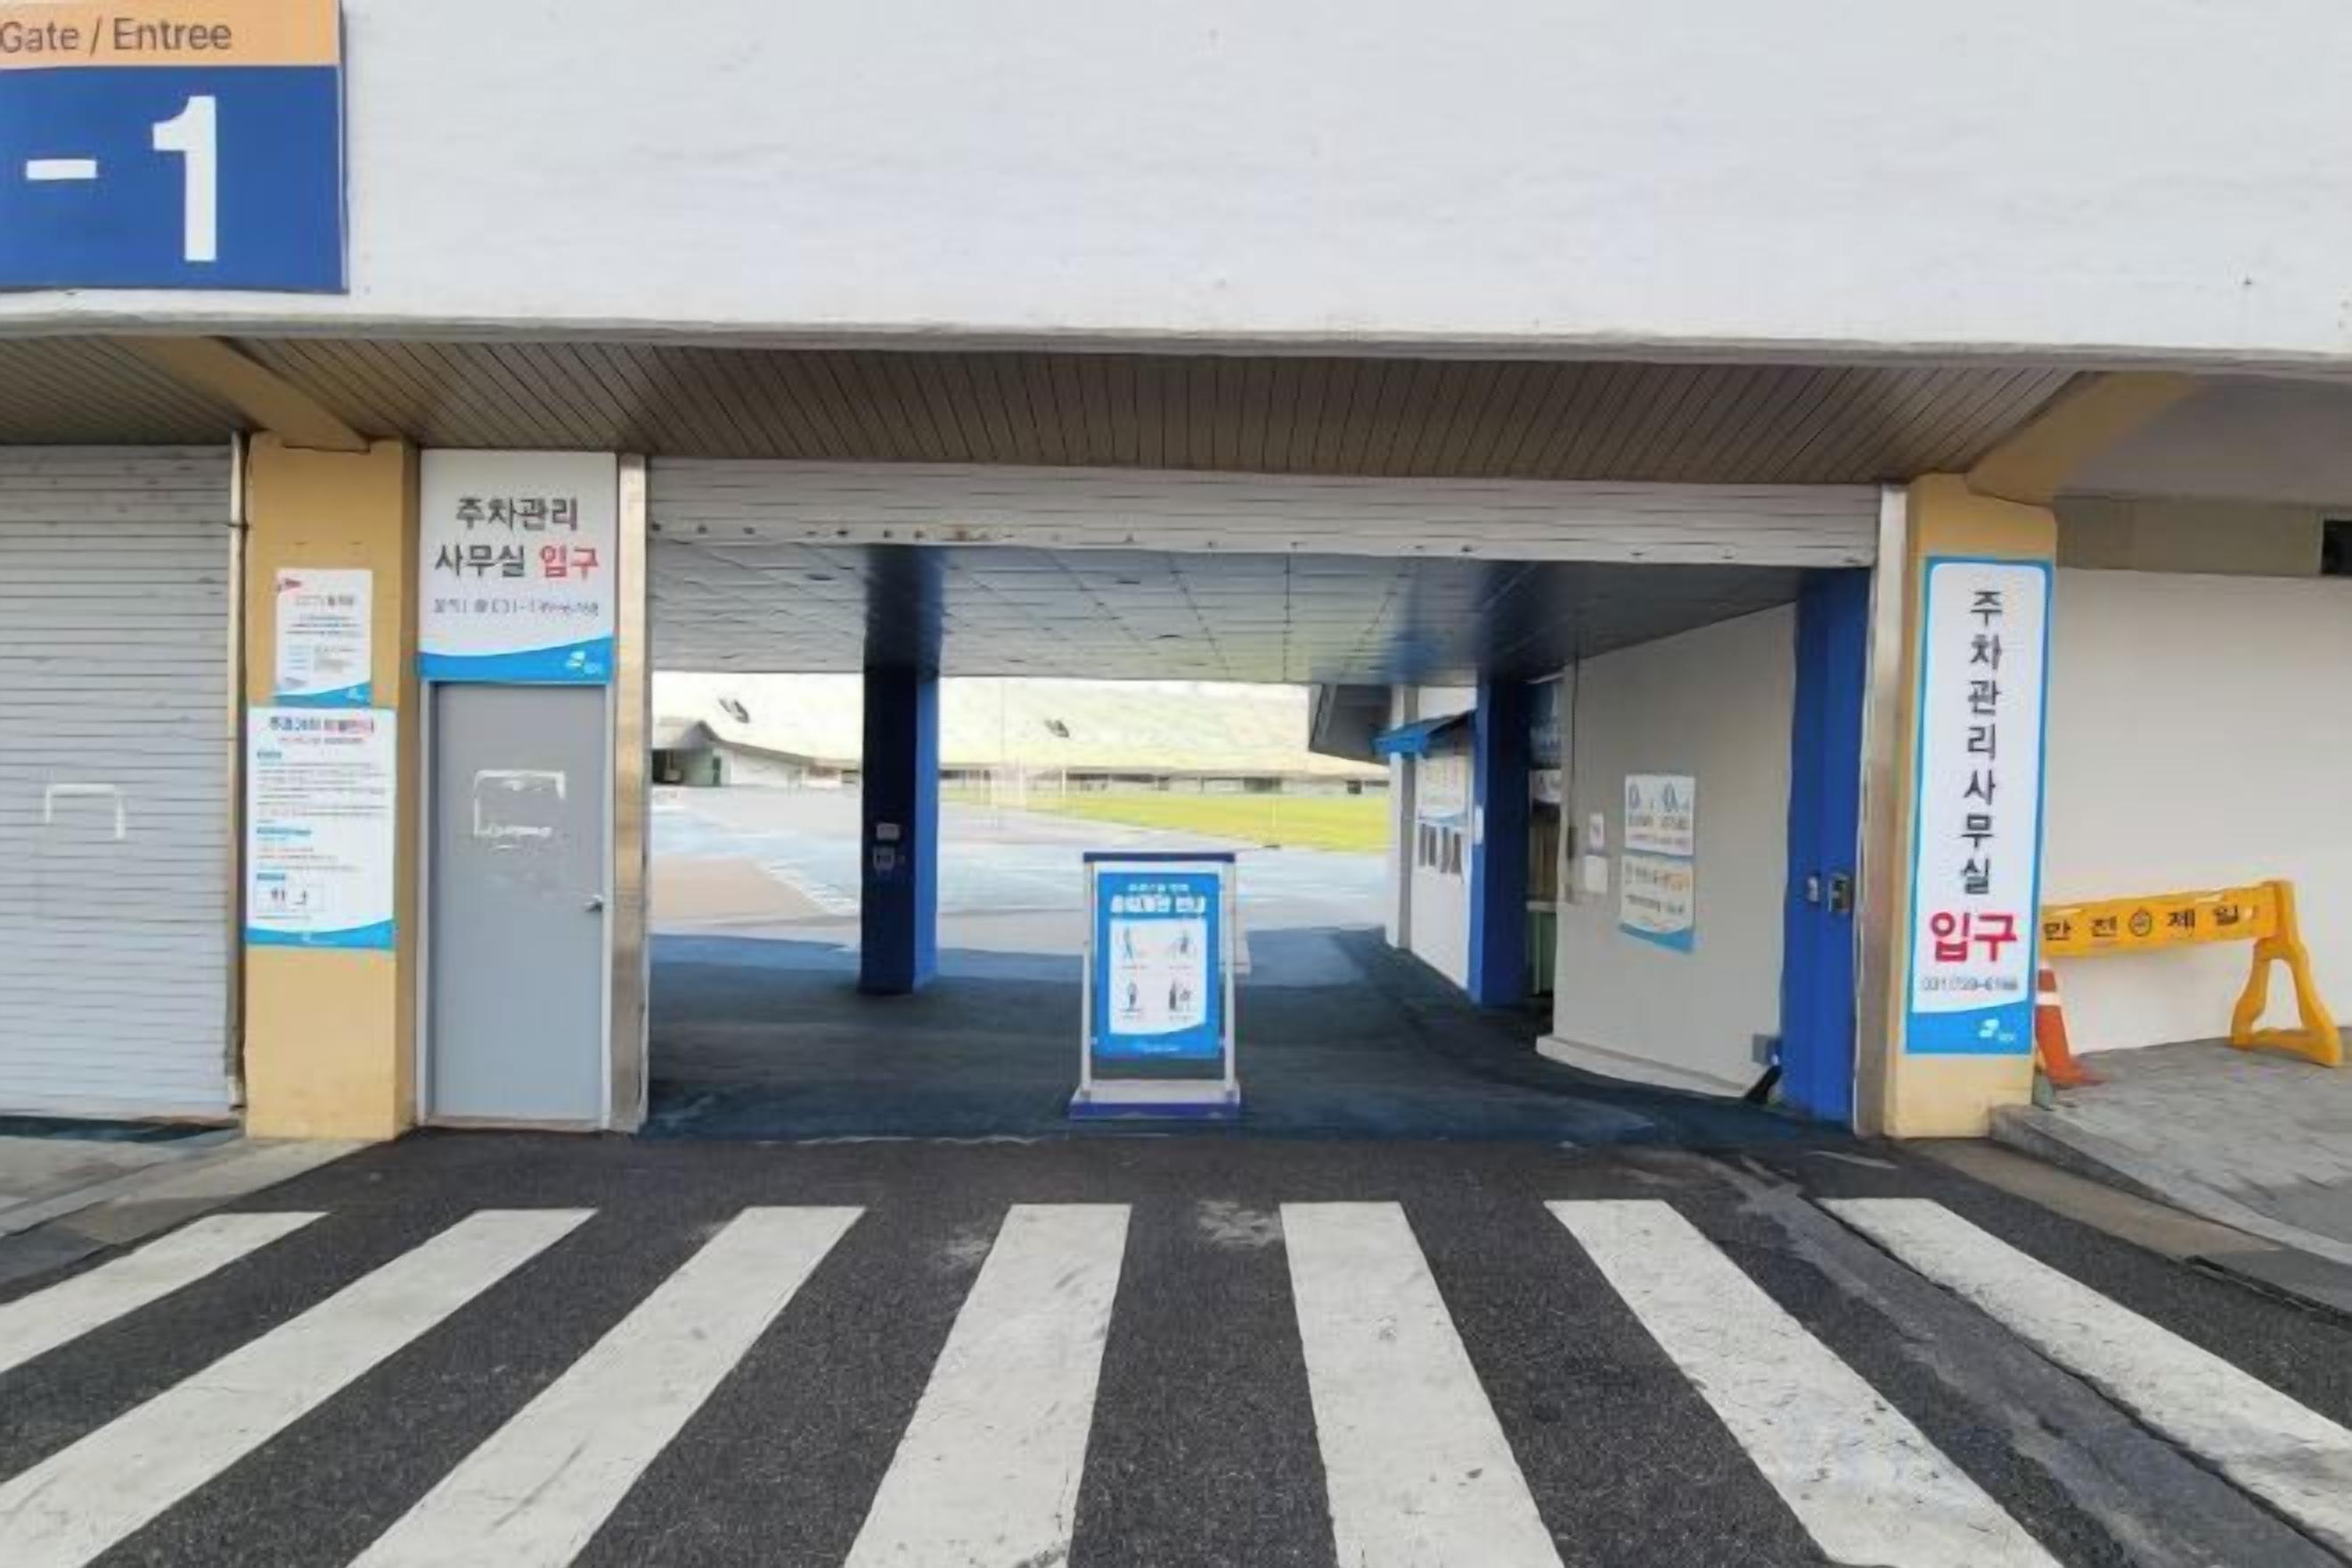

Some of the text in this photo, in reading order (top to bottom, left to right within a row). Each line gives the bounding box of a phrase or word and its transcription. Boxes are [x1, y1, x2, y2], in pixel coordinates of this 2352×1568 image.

[0, 16, 233, 56] Gate / Entree
[456, 497, 577, 531] 주차관리
[434, 544, 599, 579] 사무실 입구
[1960, 591, 2002, 894] 주차관리사무실
[1931, 911, 2017, 962] 입구
